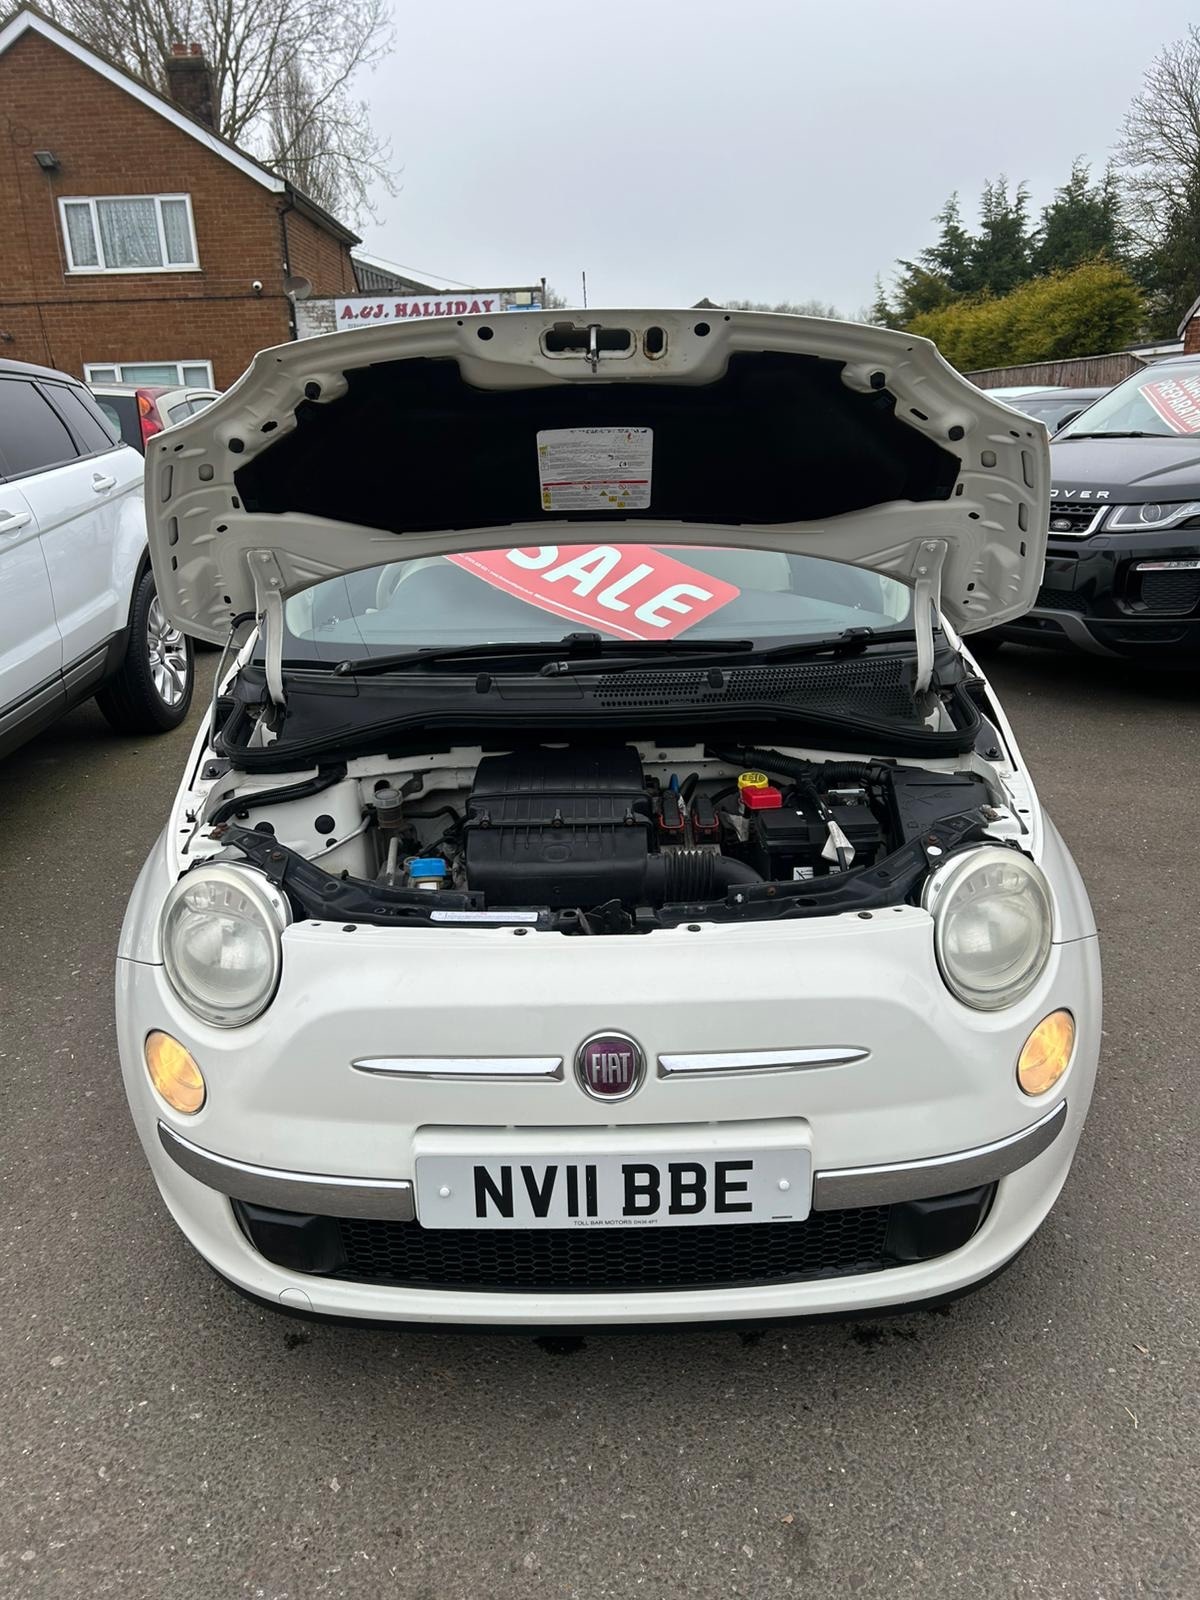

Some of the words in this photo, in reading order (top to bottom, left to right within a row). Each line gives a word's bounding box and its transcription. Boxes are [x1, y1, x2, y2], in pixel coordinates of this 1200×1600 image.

[394, 299, 495, 318] HALLIDAY
[591, 1052, 631, 1084] FIAT
[473, 1164, 598, 1218] NV11
[621, 1160, 753, 1216] BBE
